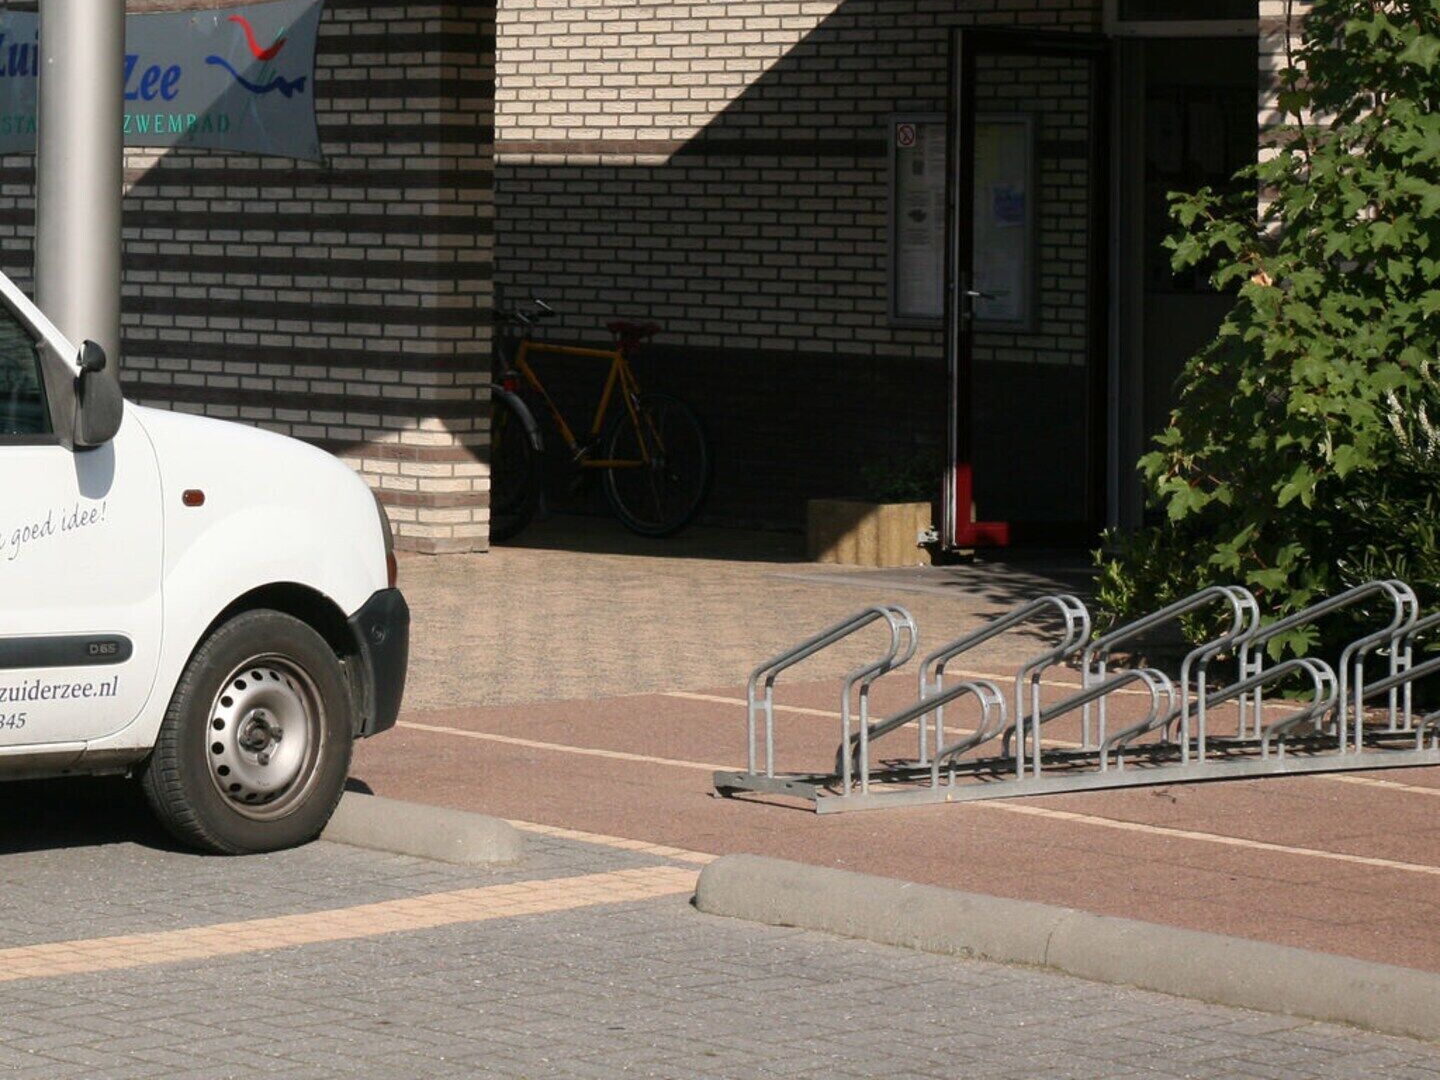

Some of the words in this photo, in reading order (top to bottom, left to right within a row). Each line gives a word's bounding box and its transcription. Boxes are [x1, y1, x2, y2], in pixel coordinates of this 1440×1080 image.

[123, 112, 230, 134] ZWEMBAD
[9, 509, 54, 561] goed
[61, 501, 109, 537] idee!
